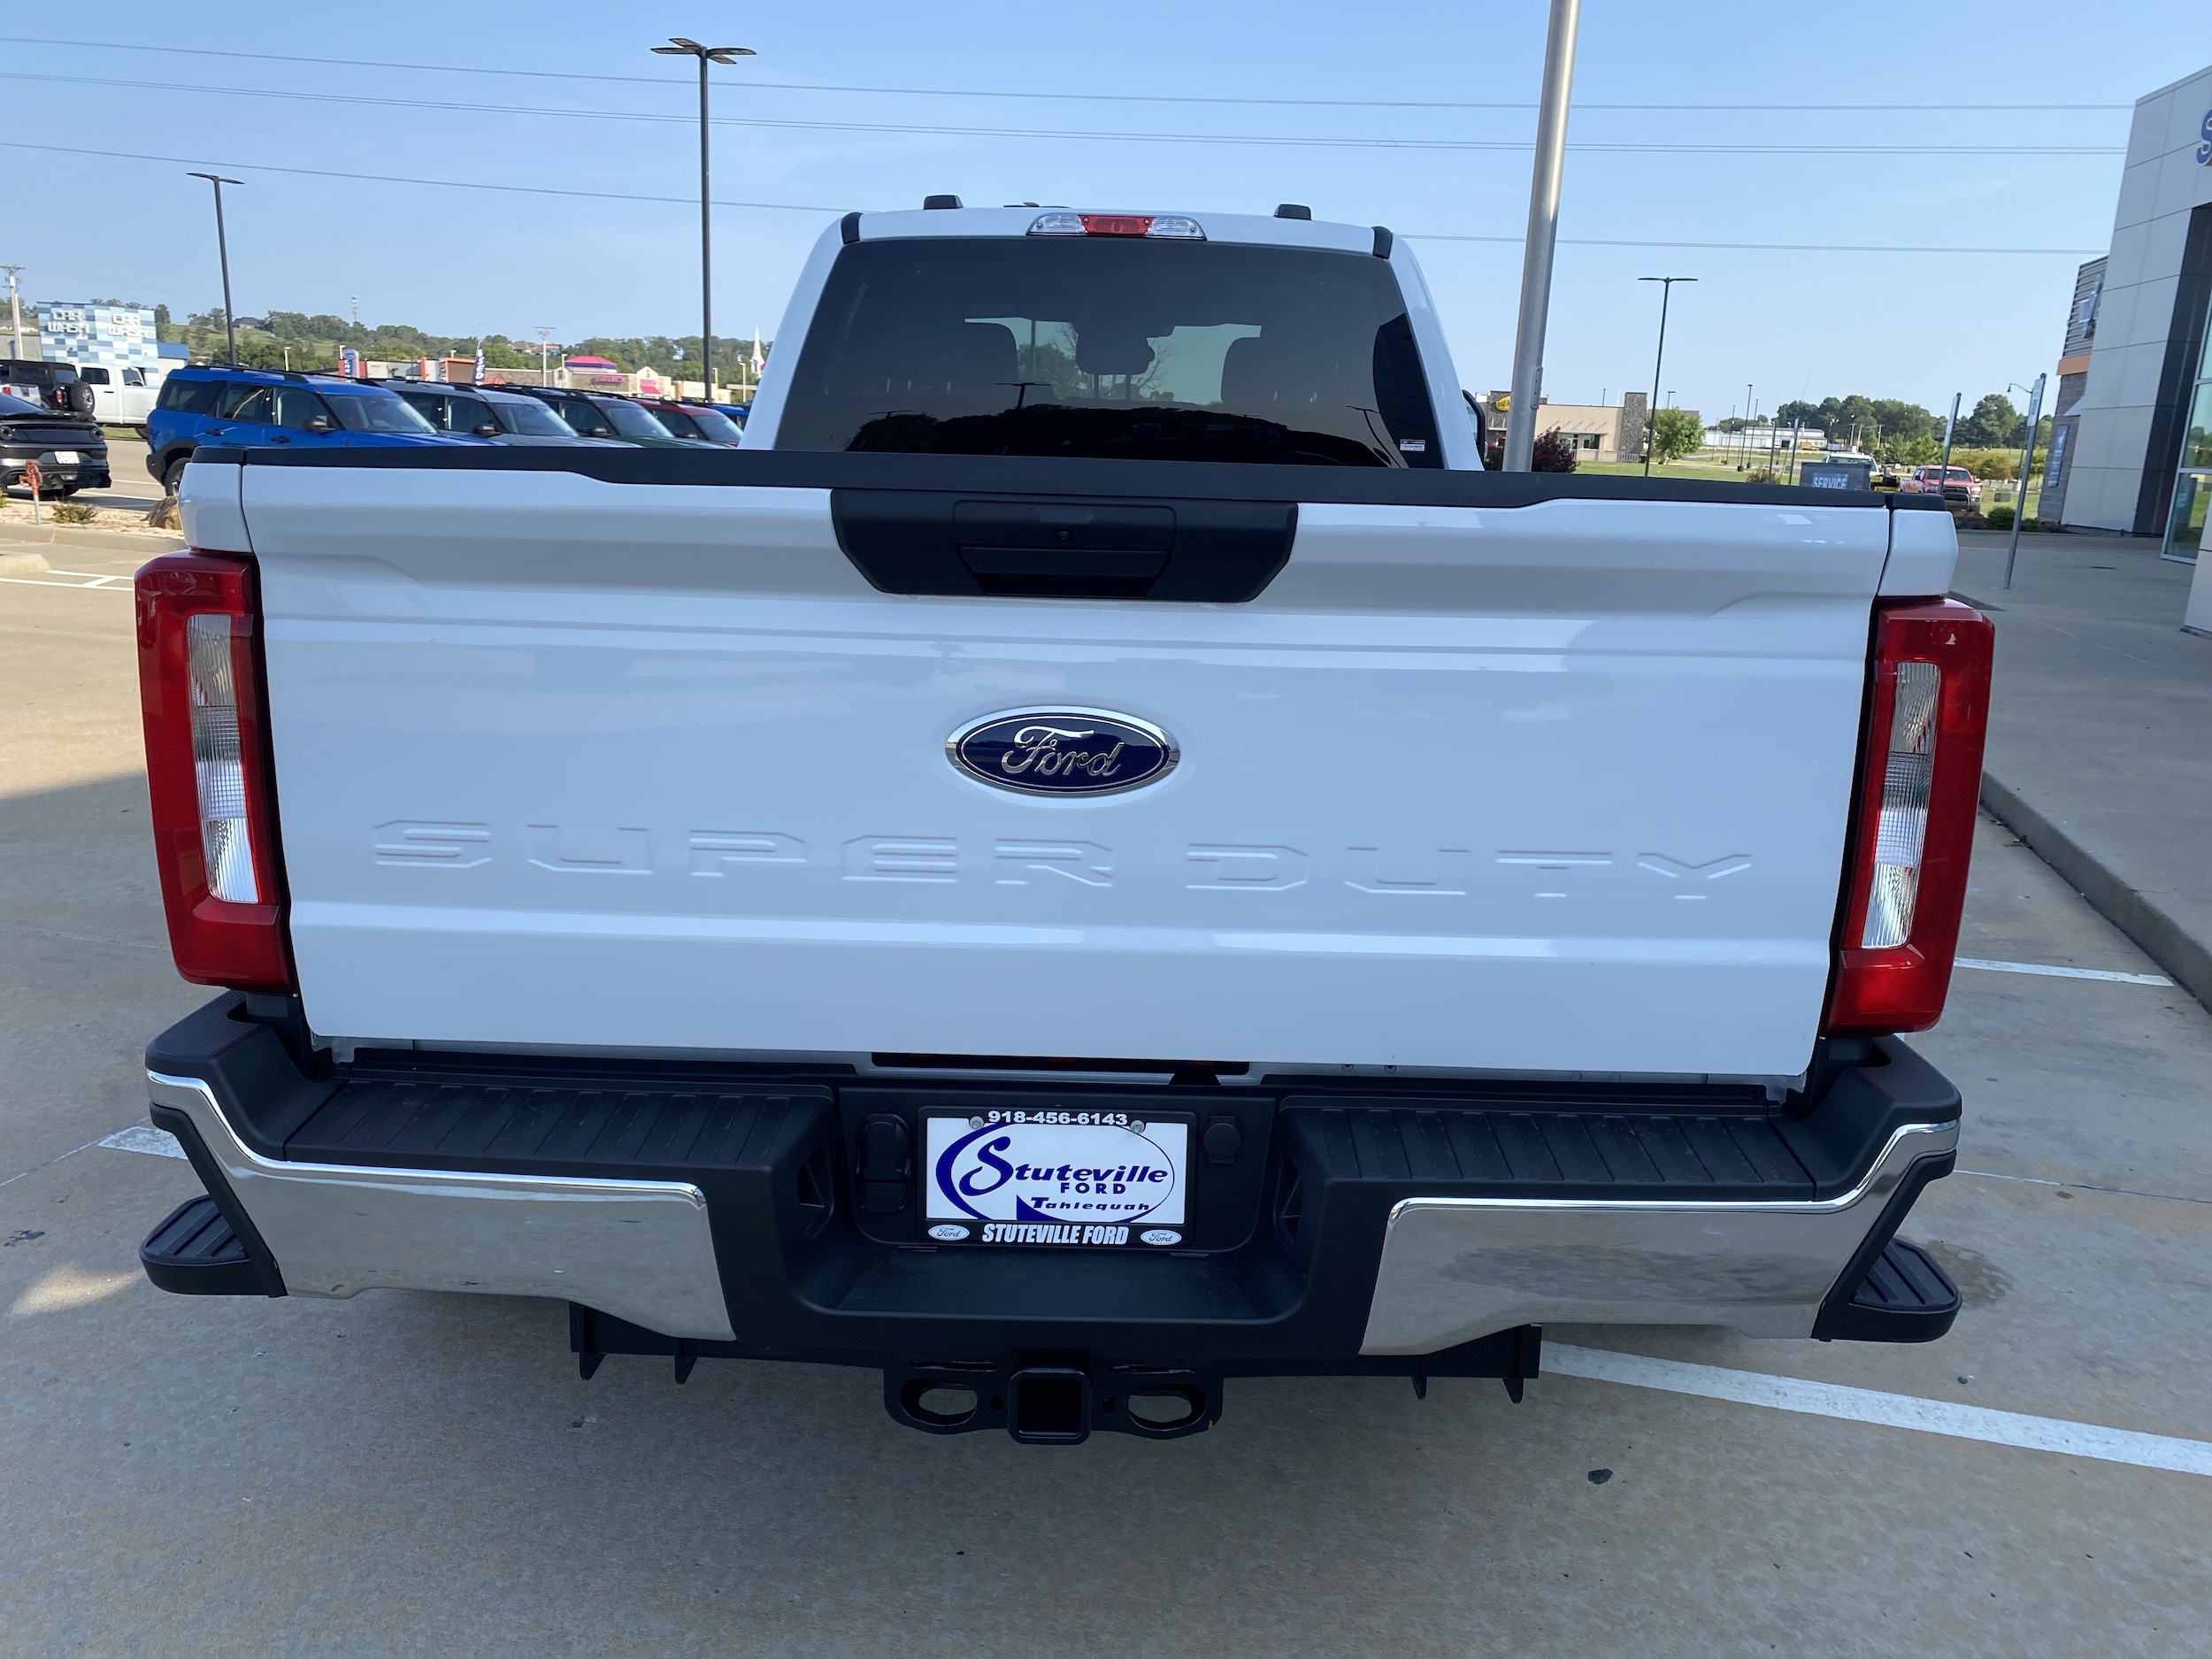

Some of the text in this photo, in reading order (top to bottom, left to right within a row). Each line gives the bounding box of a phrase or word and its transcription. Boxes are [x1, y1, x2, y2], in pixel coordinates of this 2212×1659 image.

[53, 310, 82, 321] CAR
[112, 312, 141, 326] CAR
[47, 321, 89, 335] WASH
[108, 326, 149, 339] WASH
[1813, 475, 1847, 489] SERVICE
[1001, 725, 1125, 776] Ford
[373, 820, 1752, 899] SUPER DUTY
[987, 1110, 1128, 1125] 918-456-6143
[958, 1136, 1168, 1196] Stuteville
[1060, 1182, 1126, 1194] FORD
[1030, 1197, 1149, 1211] Tahlequah
[936, 1228, 961, 1238] Ford
[982, 1224, 1129, 1245] STUTEVILLE FORD
[1148, 1232, 1174, 1243] Ford
